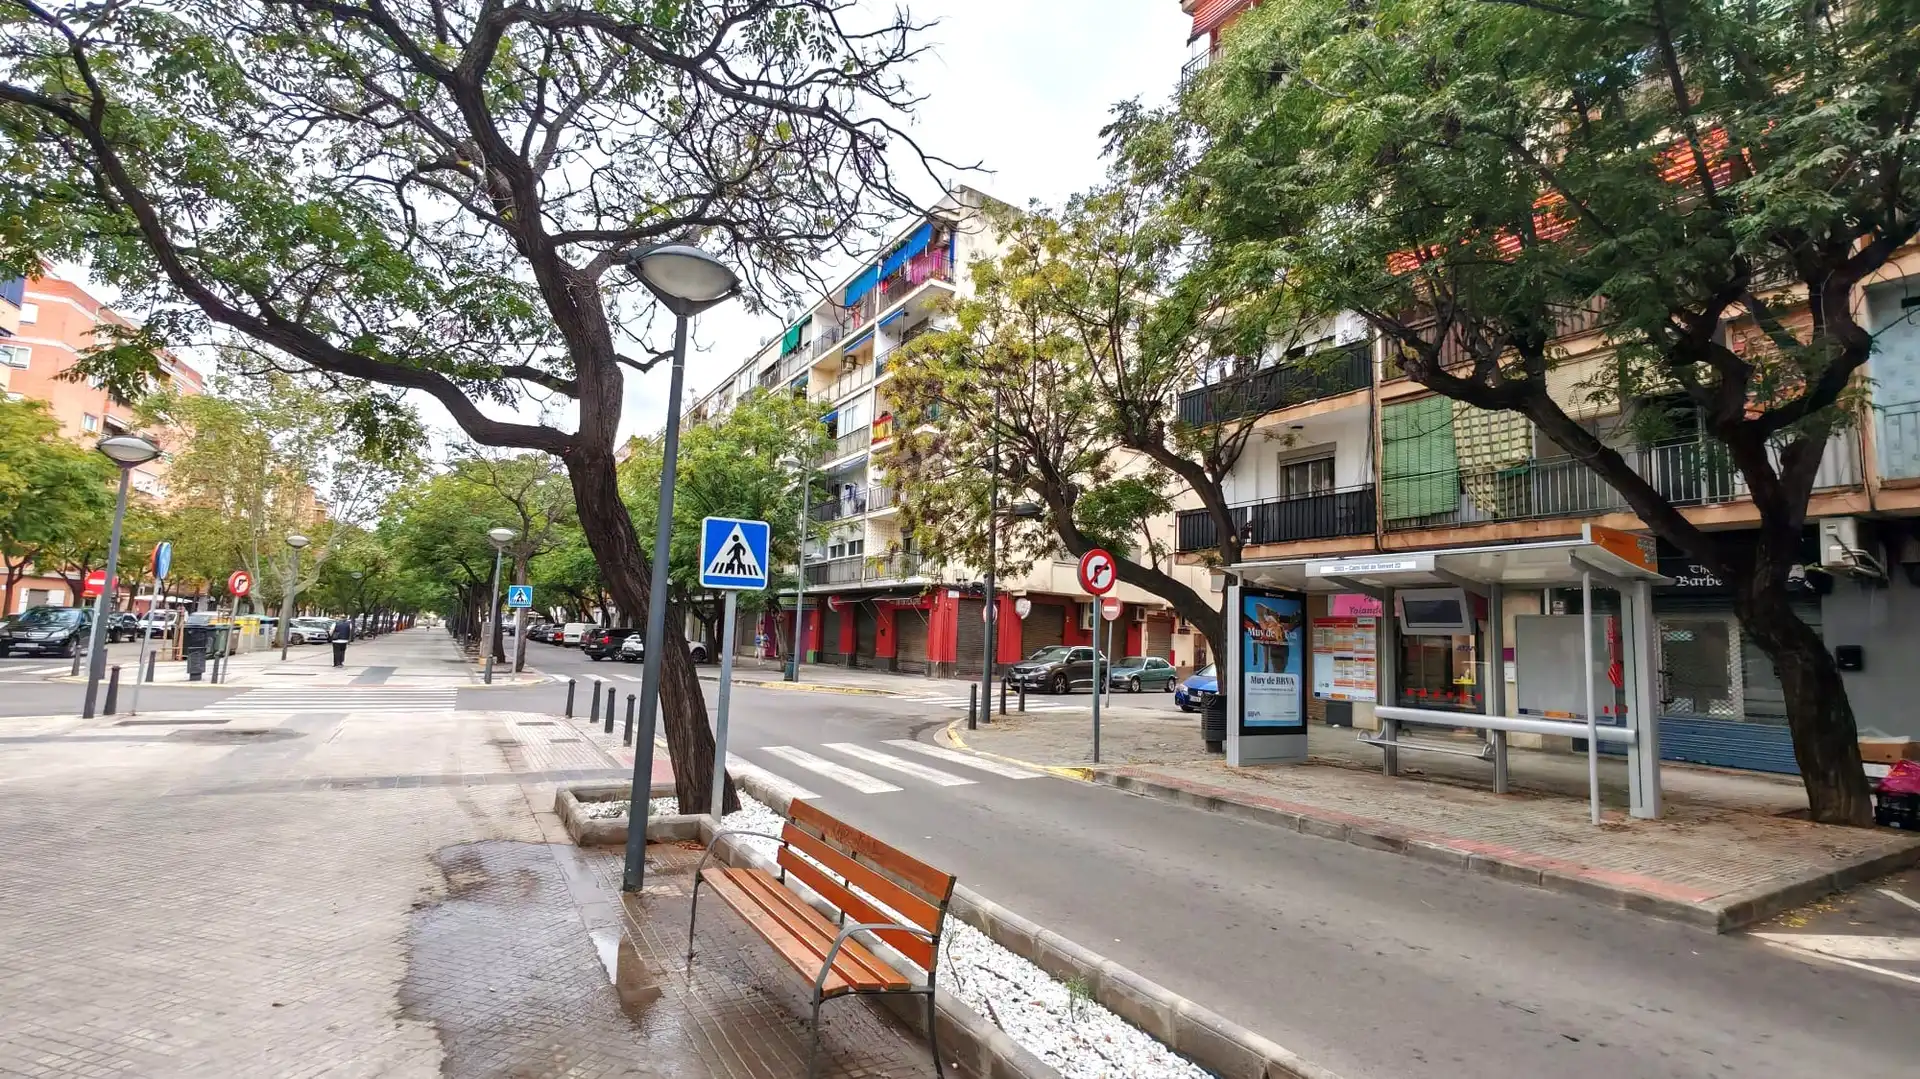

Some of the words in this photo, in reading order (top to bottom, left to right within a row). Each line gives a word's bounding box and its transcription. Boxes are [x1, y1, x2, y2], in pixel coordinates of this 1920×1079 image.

[1247, 627, 1264, 638] Muy
[1266, 629, 1275, 638] de
[1250, 675, 1265, 686] Muy
[1266, 676, 1275, 685] de
[1276, 677, 1294, 685] BBVA
